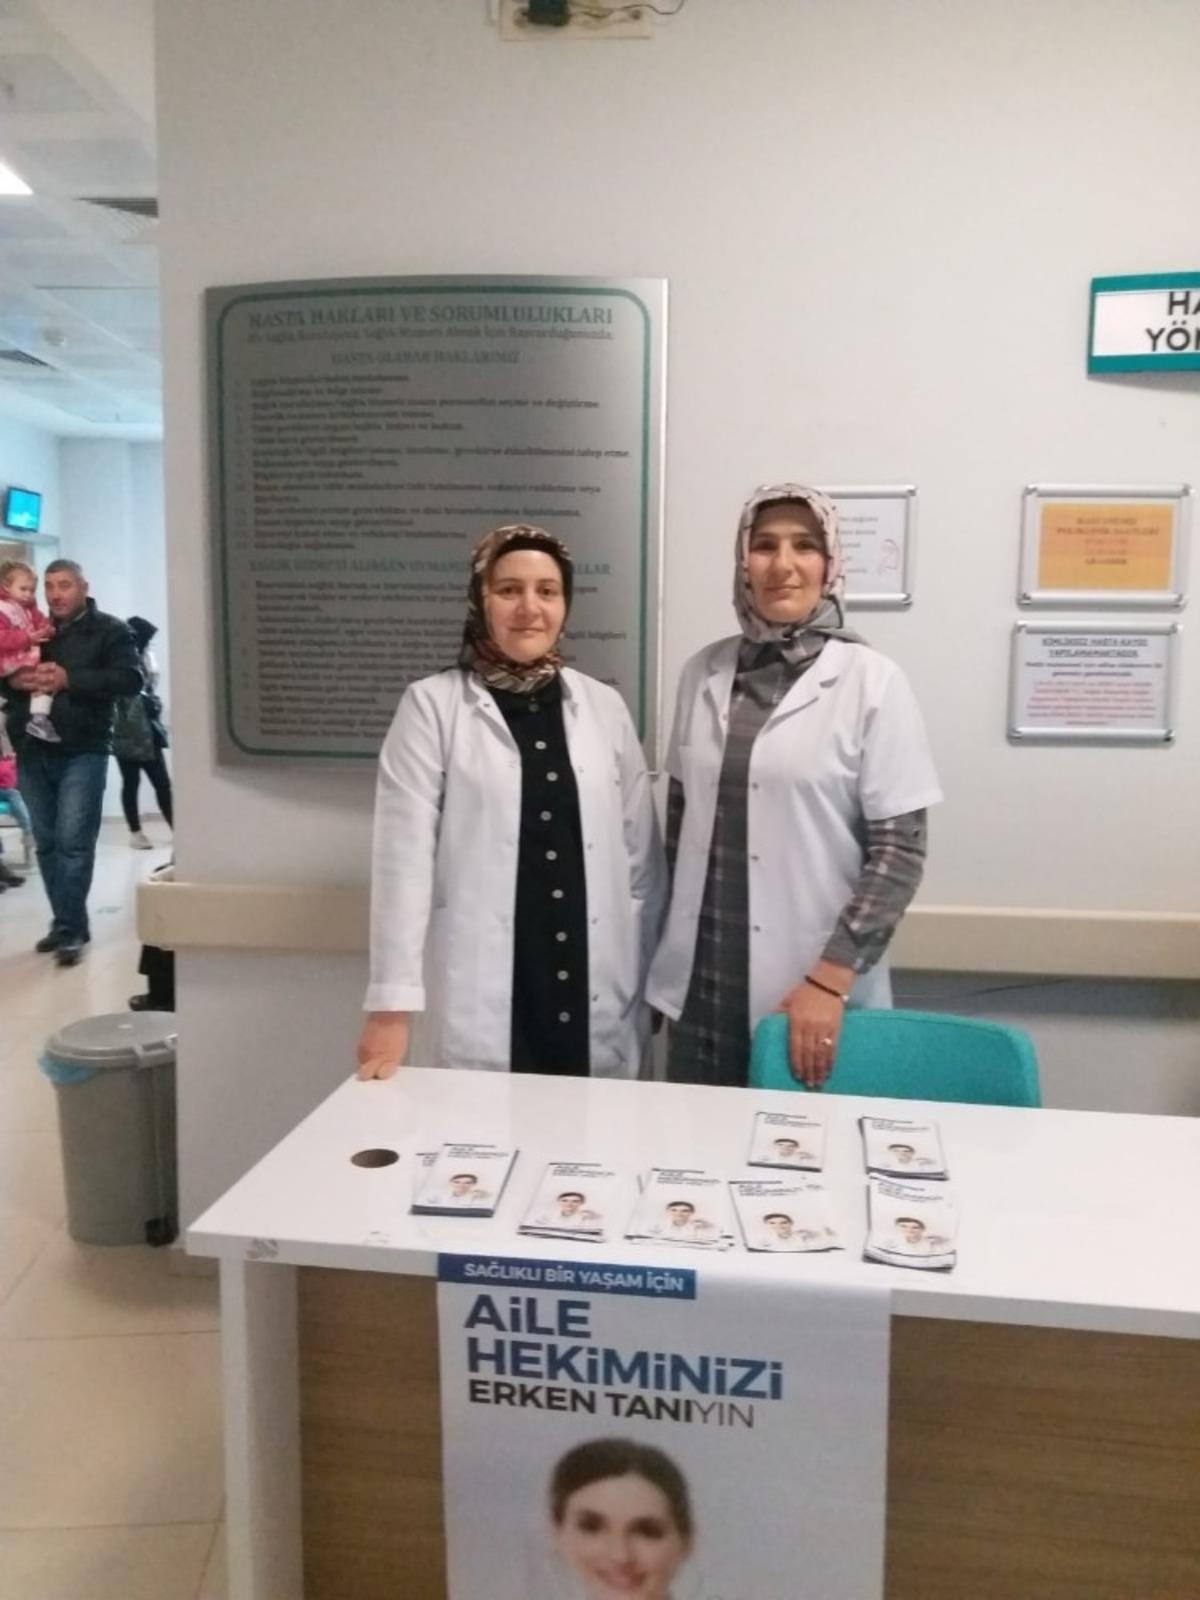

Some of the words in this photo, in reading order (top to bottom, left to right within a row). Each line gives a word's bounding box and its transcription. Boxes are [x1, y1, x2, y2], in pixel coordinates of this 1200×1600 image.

[249, 311, 306, 328] HASTA
[310, 306, 396, 325] HAKLARI
[399, 305, 427, 322] VE
[429, 305, 613, 324] SORUMLULUKLARI
[1145, 320, 1200, 352] YÖ
[464, 1261, 541, 1282] SAĞLIKLI
[544, 1265, 575, 1284] BİR
[579, 1270, 643, 1289] YAŞAM
[646, 1270, 684, 1293] İÇİN
[468, 1378, 597, 1416] ERKEN
[604, 1391, 755, 1430] TANIYIN
